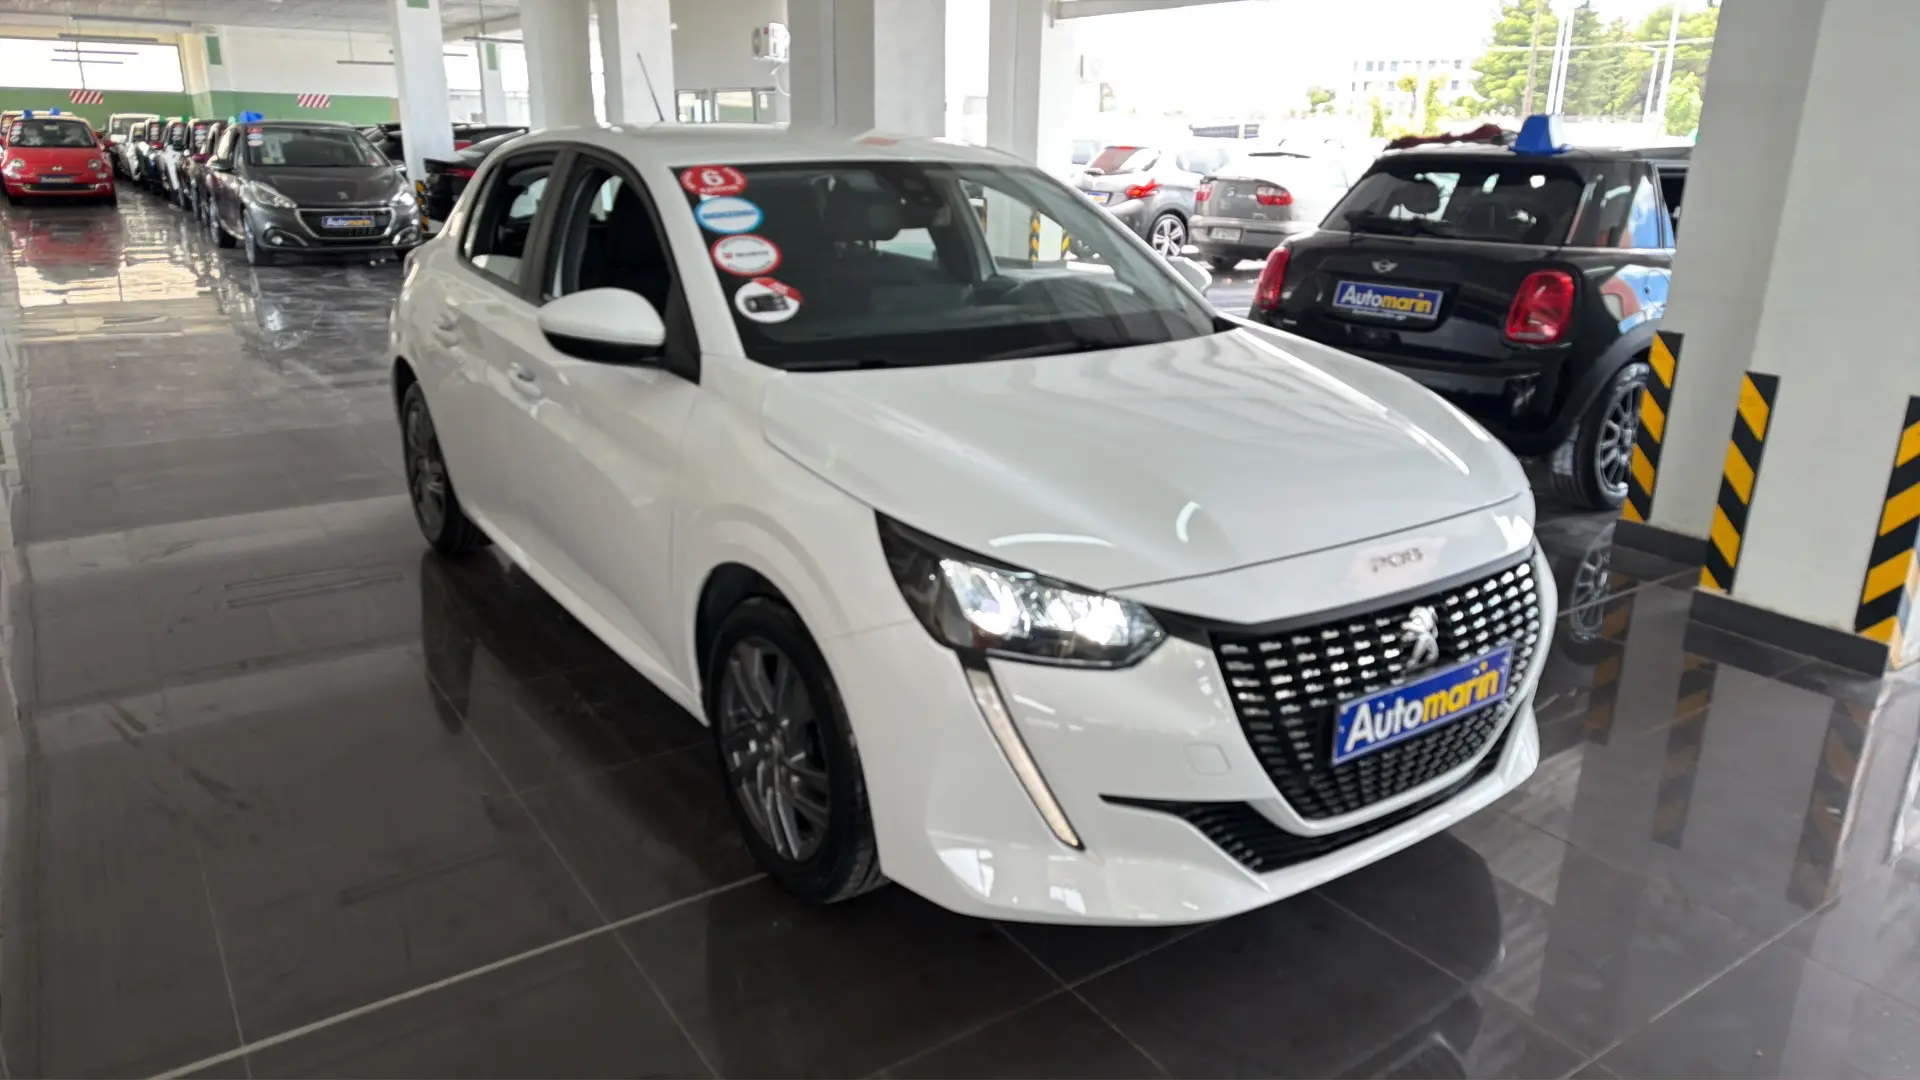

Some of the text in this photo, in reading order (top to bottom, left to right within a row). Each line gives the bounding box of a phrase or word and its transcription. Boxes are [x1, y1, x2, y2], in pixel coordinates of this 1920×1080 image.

[701, 169, 724, 186] 6
[1340, 285, 1433, 314] Automarin
[1344, 661, 1500, 752] Automarin
